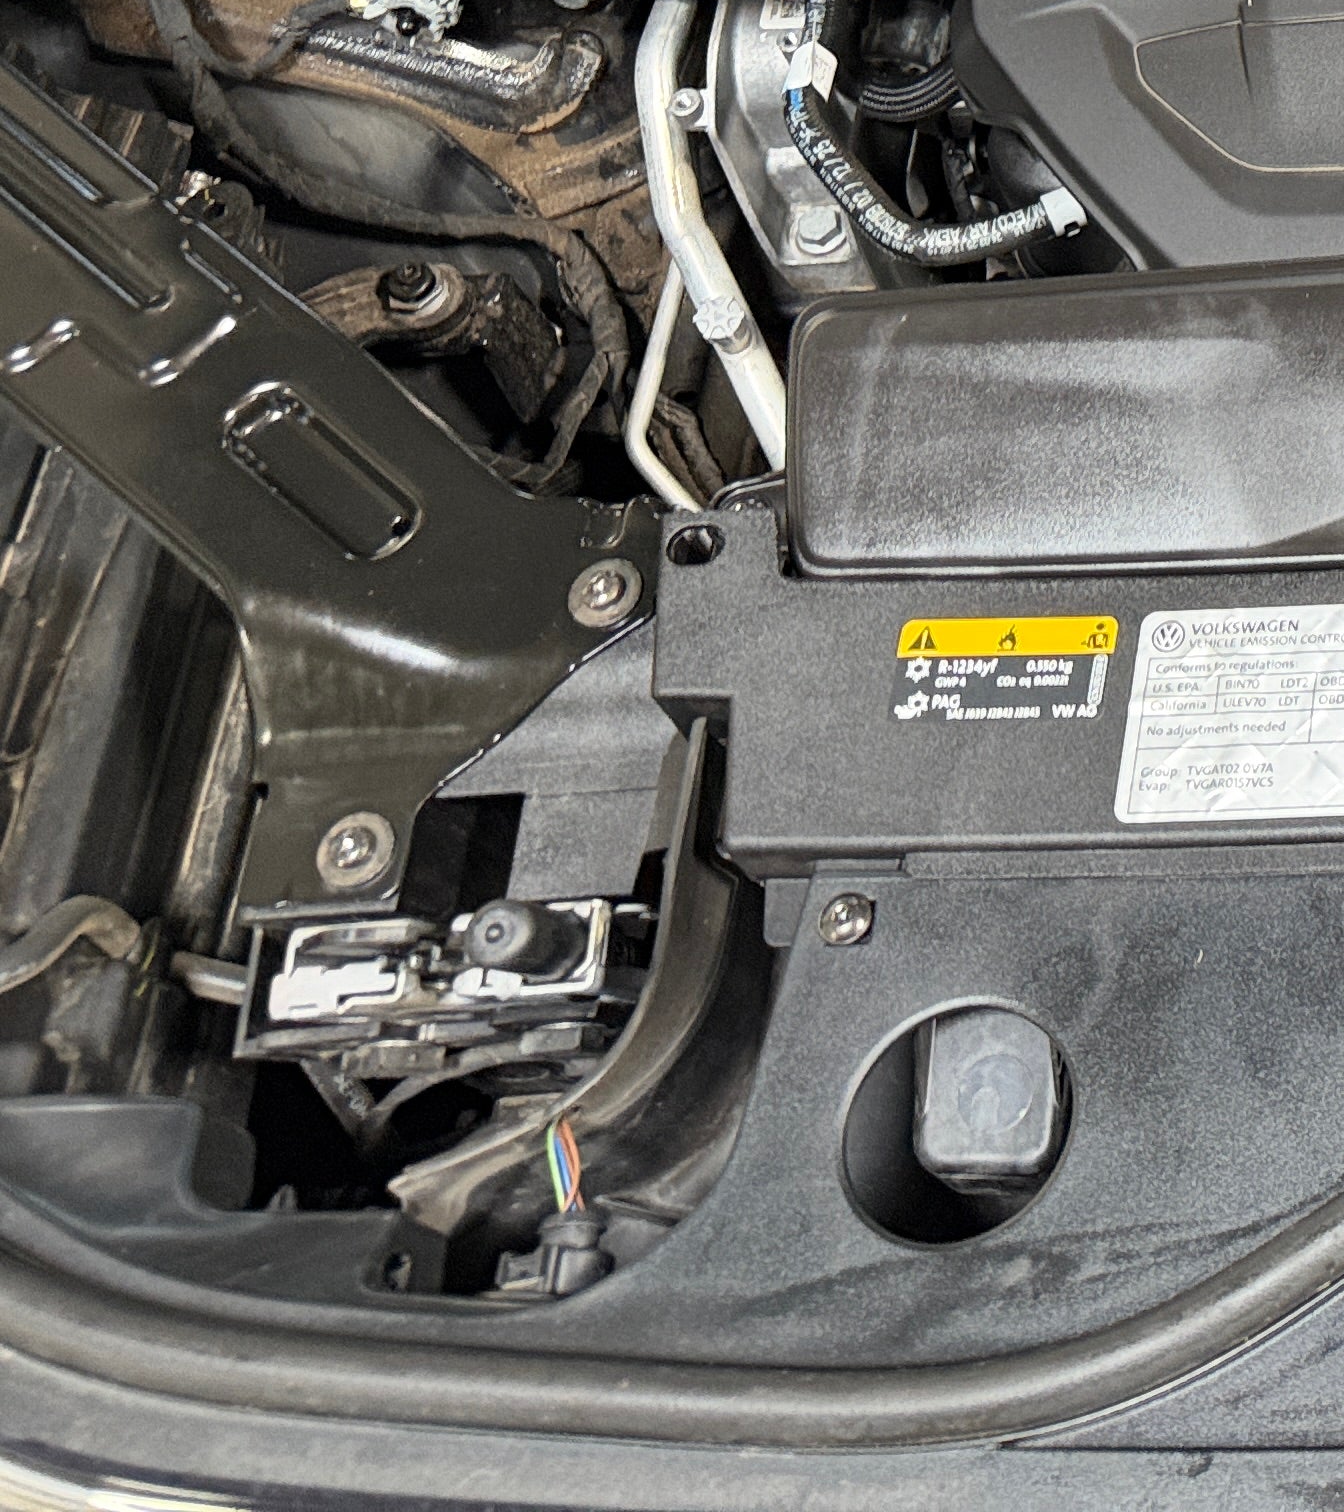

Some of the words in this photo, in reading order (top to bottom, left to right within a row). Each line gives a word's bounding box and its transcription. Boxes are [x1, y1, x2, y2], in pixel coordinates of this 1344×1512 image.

[1191, 619, 1300, 637] VOLKSWAGEN
[1189, 636, 1237, 649] VEHICLE
[1239, 635, 1298, 648] EMISSION
[937, 657, 999, 678] R-1234yf
[1058, 658, 1074, 675] kg
[1155, 660, 1212, 674] Conforms
[1215, 659, 1226, 671] to
[935, 677, 957, 688] GWP
[1153, 683, 1174, 694] U.S.
[1176, 681, 1200, 693] EPA
[1225, 678, 1261, 690] BIN70
[1280, 677, 1309, 689] LDT2
[931, 694, 961, 711] PAG
[1150, 698, 1207, 712] California
[1223, 697, 1267, 709] ULEV70
[1278, 695, 1300, 707] LDT
[1051, 703, 1077, 719] VW
[1076, 703, 1099, 719] AG
[1146, 726, 1163, 736] No
[1166, 723, 1240, 738] adjustments
[1242, 720, 1287, 733] needed
